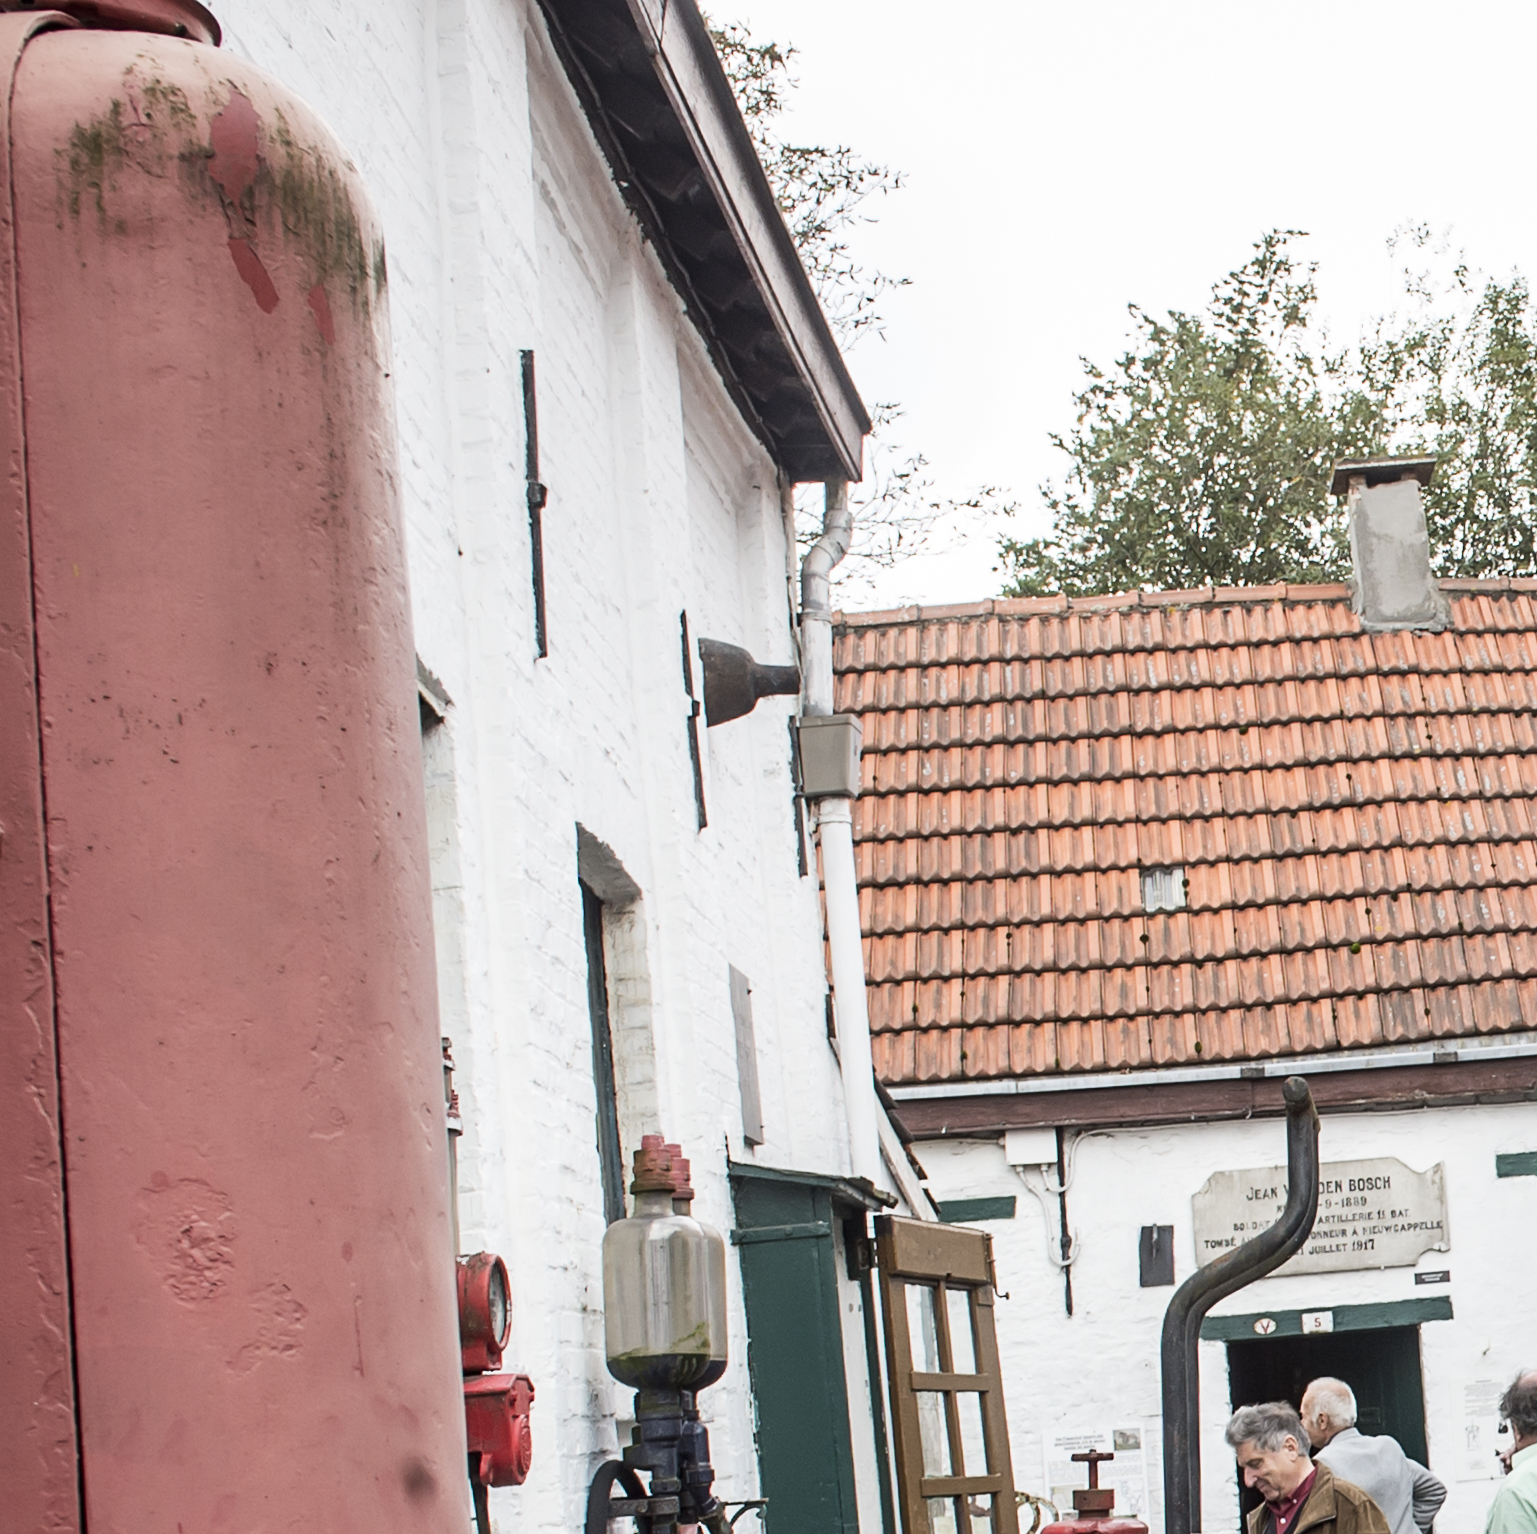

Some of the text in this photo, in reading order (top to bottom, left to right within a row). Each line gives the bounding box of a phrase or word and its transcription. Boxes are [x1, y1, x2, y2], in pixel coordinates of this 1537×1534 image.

[1246, 1187, 1278, 1201] JEAN
[1349, 1176, 1391, 1192] BOSCH
[1317, 1211, 1374, 1225] ARTILLERIE
[1309, 1243, 1348, 1255] JUILLET
[1352, 1239, 1375, 1252] 1917
